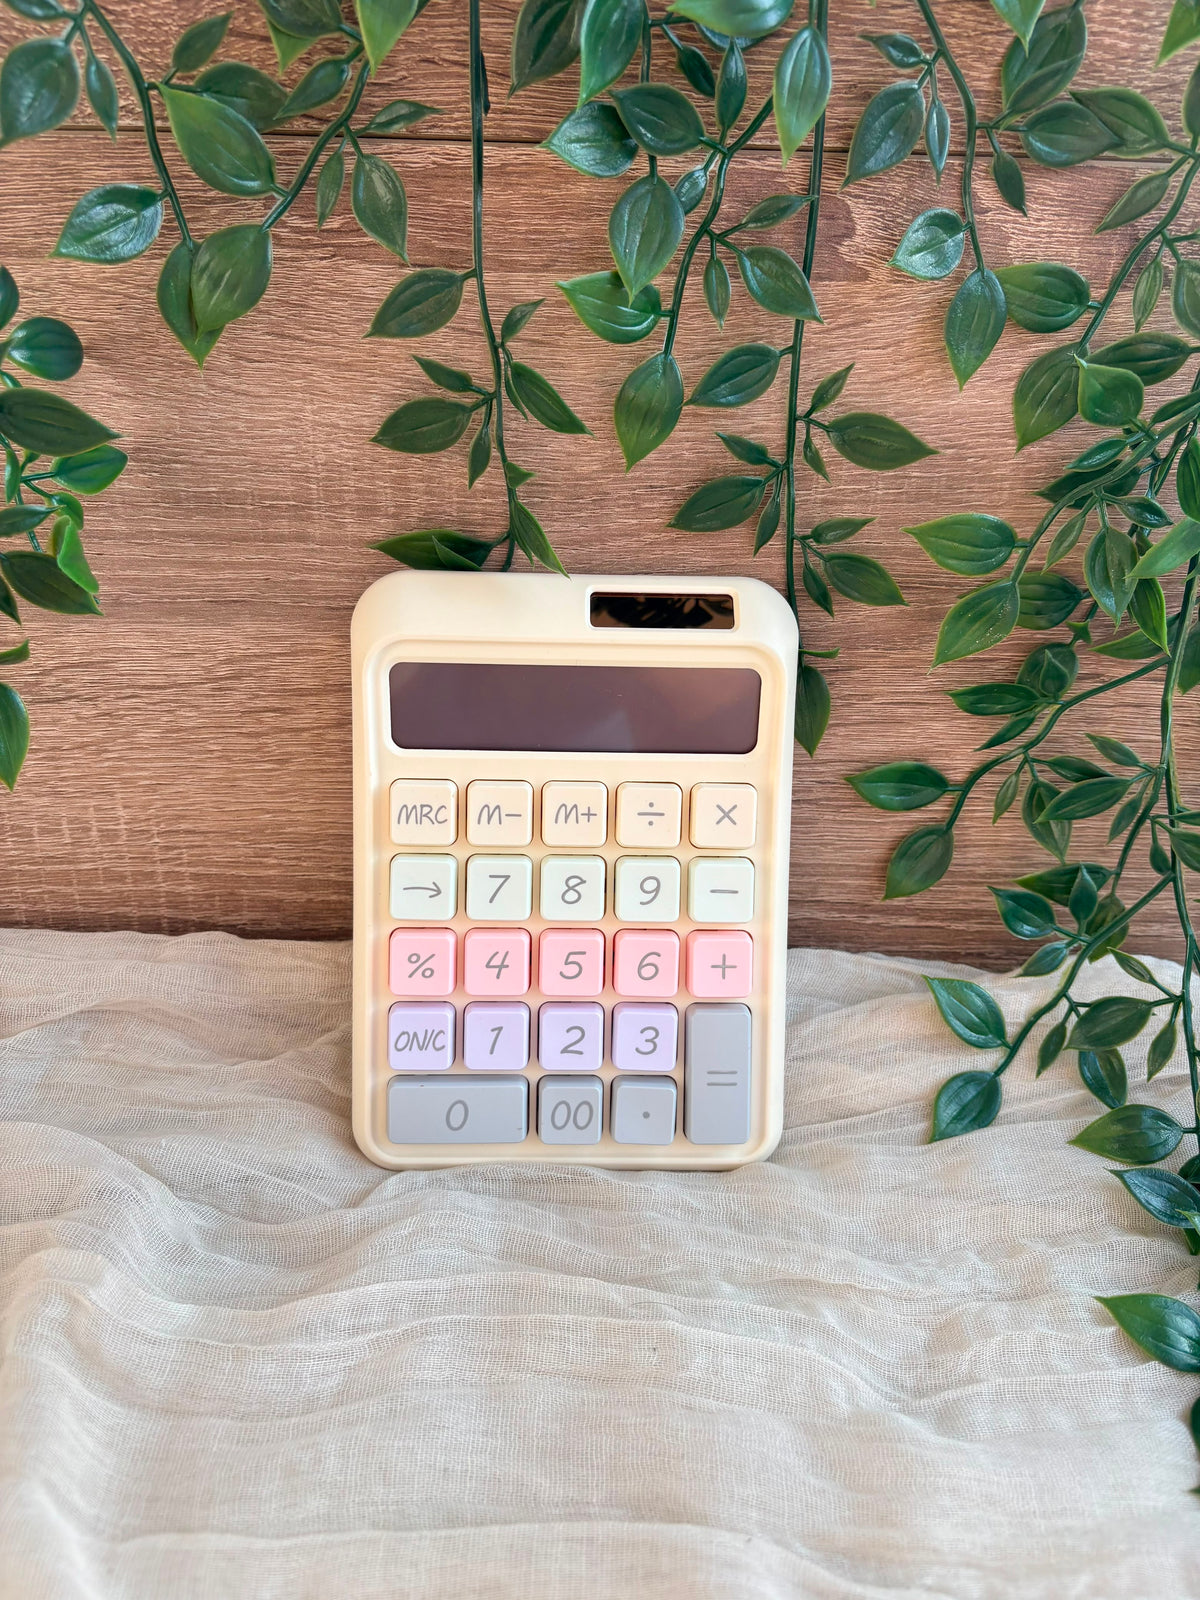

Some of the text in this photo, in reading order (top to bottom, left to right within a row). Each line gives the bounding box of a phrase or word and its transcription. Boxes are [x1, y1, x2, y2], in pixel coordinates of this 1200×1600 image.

[396, 803, 449, 826] MRC
[554, 802, 598, 825] M+
[488, 874, 512, 904] 7
[560, 874, 587, 905] 8
[639, 875, 662, 906] 9
[407, 952, 436, 979] %
[484, 950, 510, 980] 4
[559, 950, 587, 980] 5
[637, 951, 662, 981] 6
[393, 1028, 446, 1053] ON/C
[489, 1025, 504, 1056] 1
[559, 1025, 586, 1056] 2
[634, 1025, 660, 1056] 3
[445, 1099, 469, 1132] 0
[550, 1100, 594, 1131] 00
